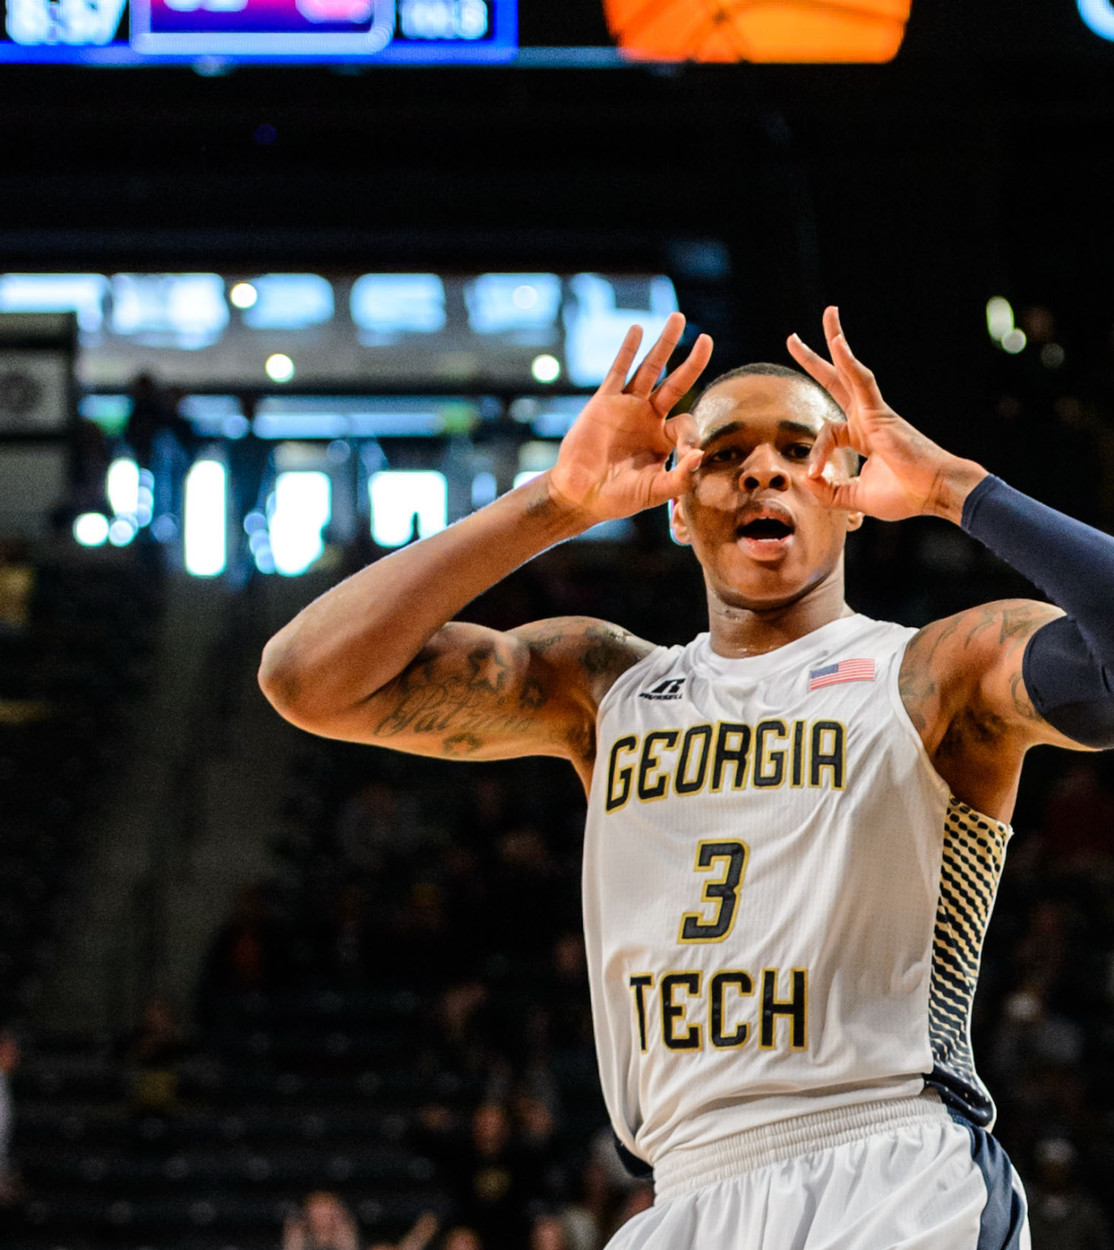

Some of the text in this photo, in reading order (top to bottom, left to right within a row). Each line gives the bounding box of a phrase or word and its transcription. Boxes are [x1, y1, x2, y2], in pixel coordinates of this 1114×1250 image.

[605, 718, 848, 815] GEORGIA
[677, 837, 750, 944] 3
[628, 967, 809, 1054] TECH
